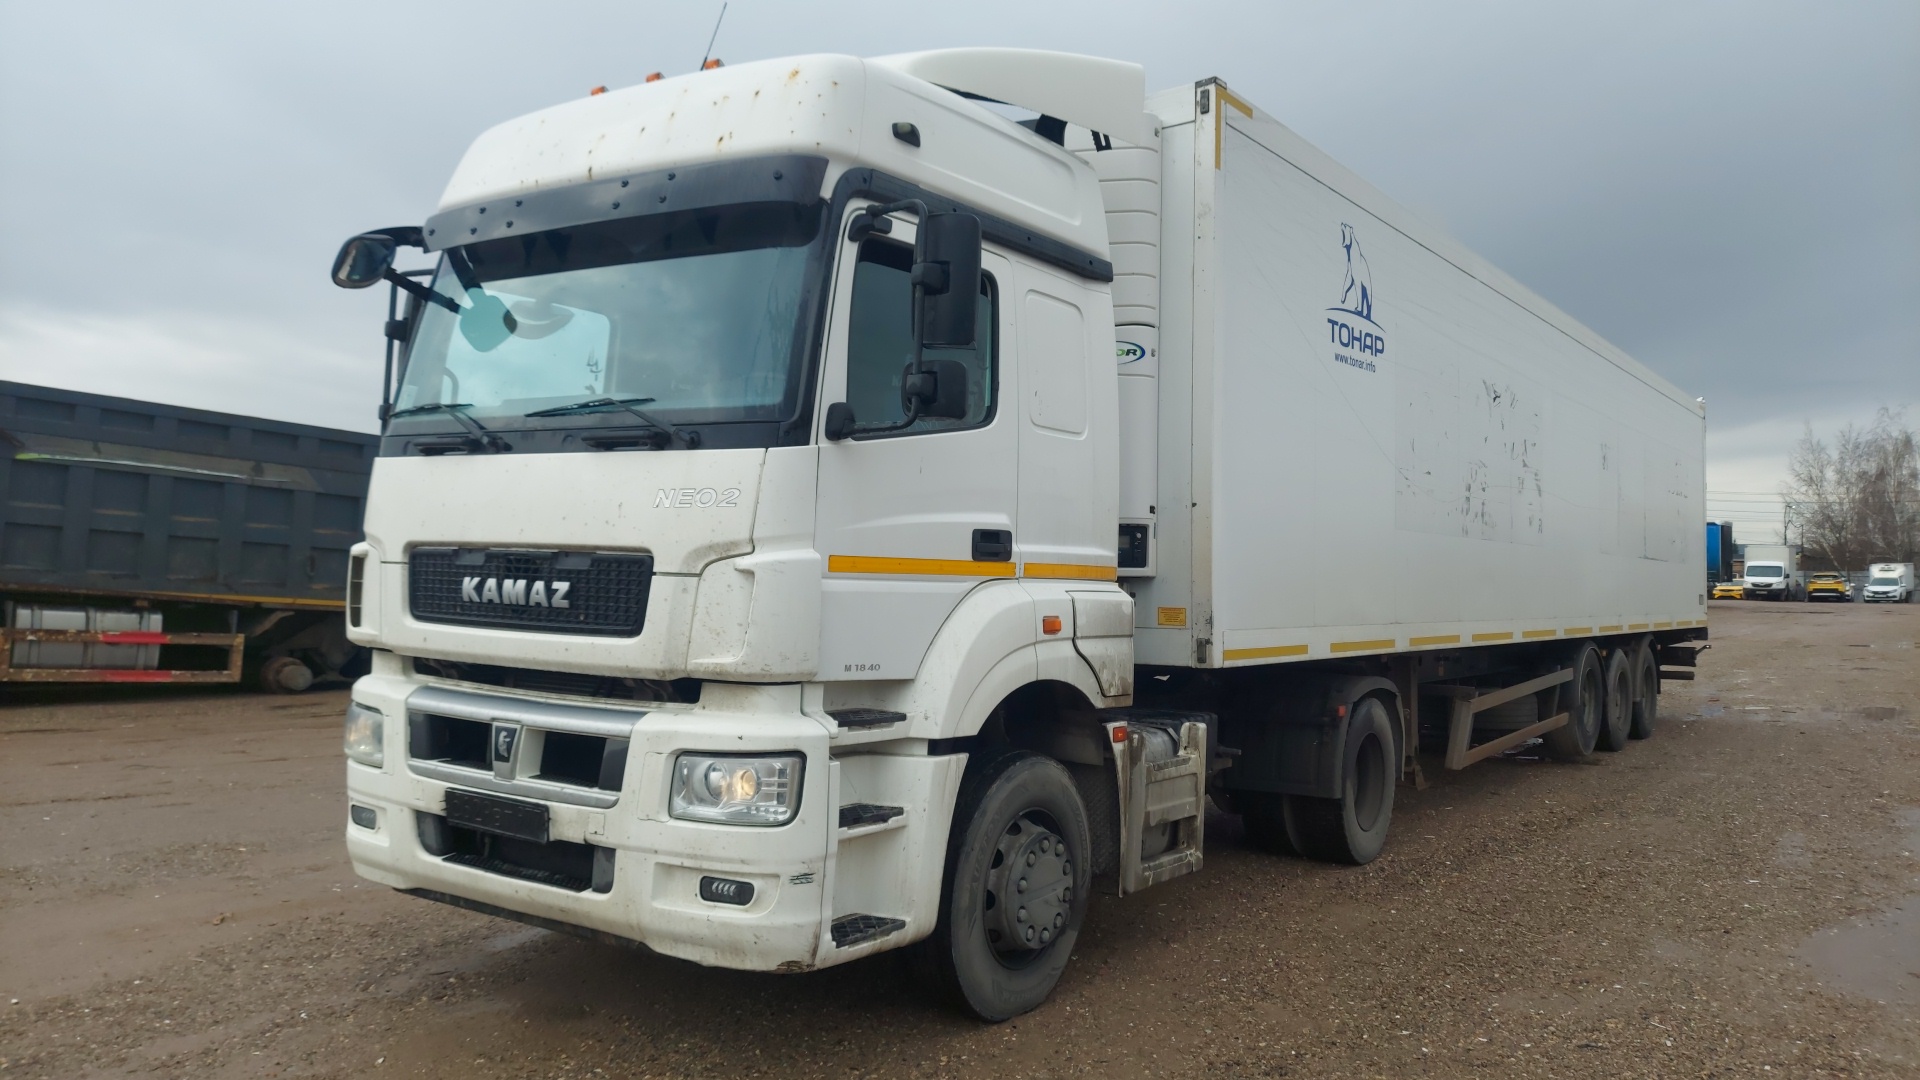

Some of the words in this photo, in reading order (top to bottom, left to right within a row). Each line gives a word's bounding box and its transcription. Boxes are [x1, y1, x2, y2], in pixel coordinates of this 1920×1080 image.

[1327, 318, 1385, 357] ТОНАР
[1335, 352, 1376, 373] www.tonar.info
[653, 487, 742, 508] NEO2
[461, 576, 571, 608] KAMAZ
